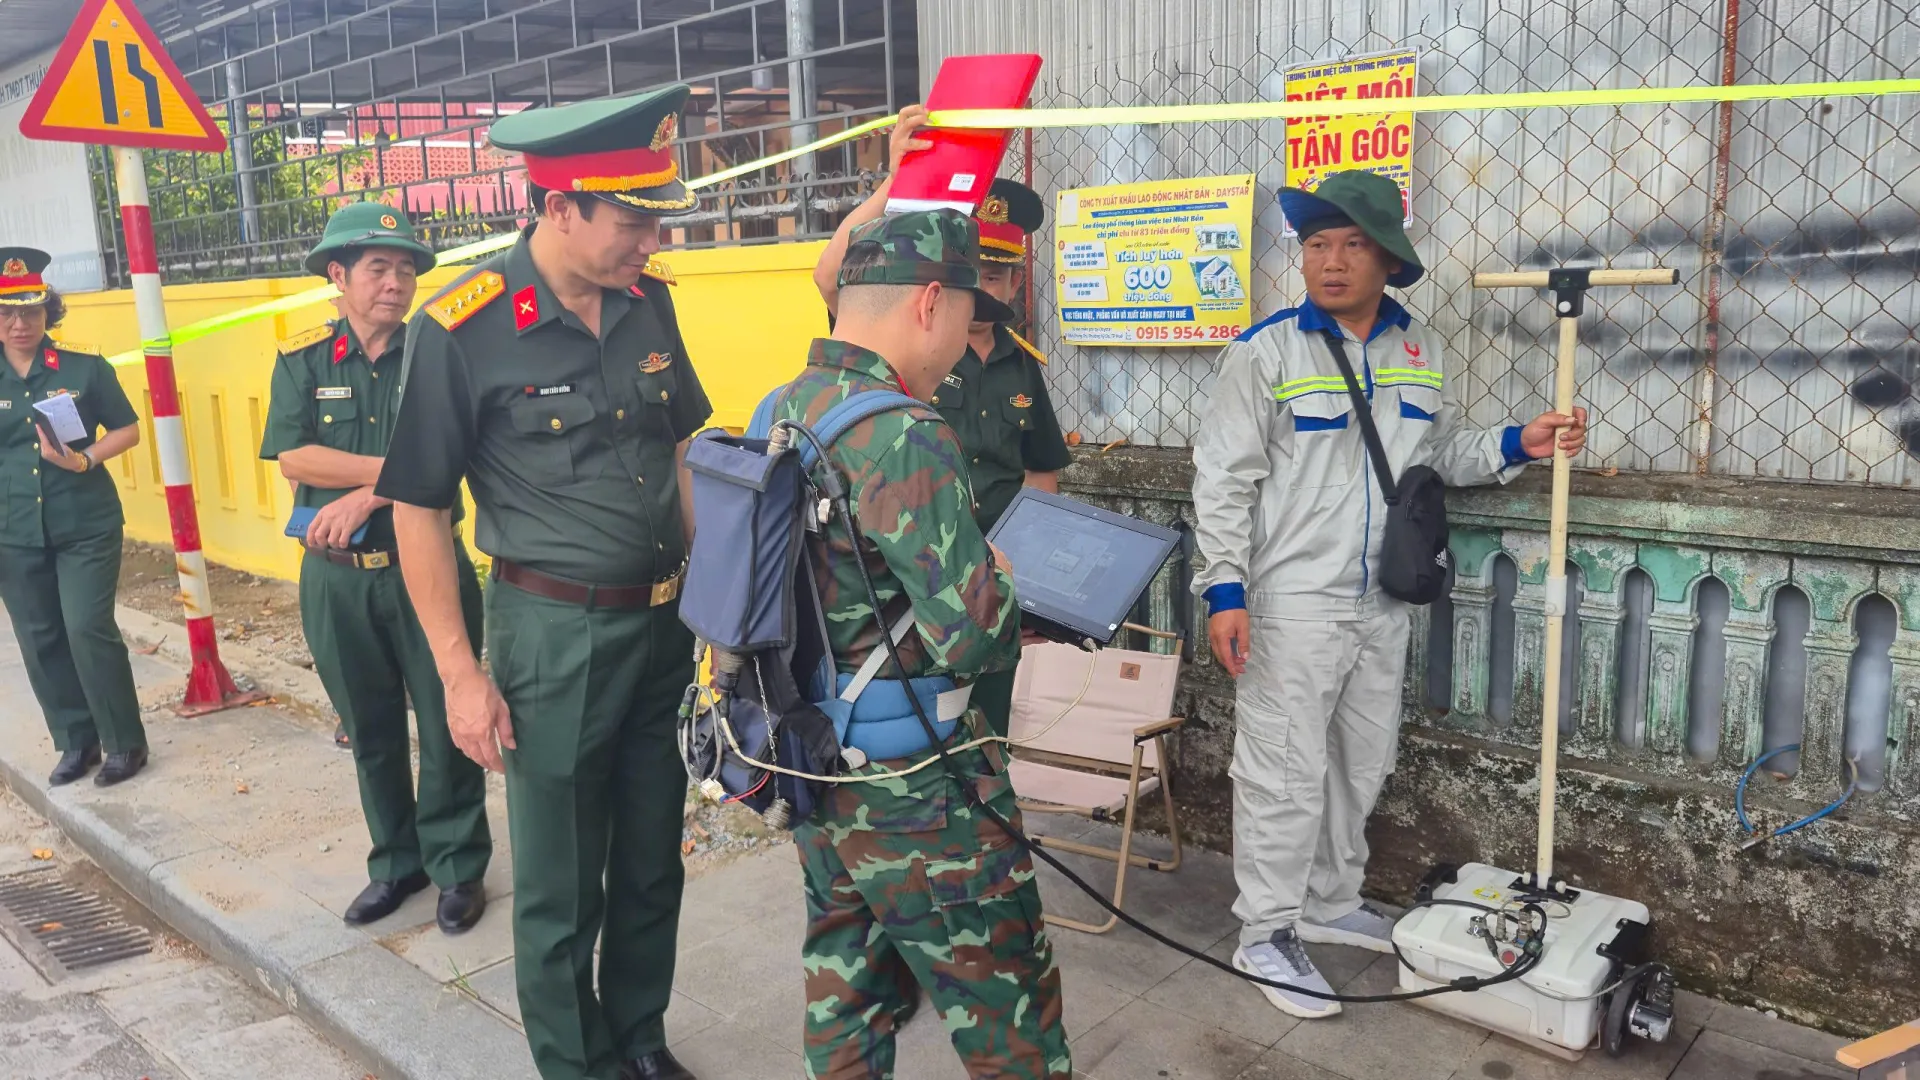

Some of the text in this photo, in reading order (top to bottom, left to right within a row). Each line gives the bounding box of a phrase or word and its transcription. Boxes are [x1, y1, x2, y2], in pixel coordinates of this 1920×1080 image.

[1288, 114, 1410, 175] TẬN GỐC
[1137, 194, 1151, 203] LAO
[1152, 190, 1172, 203] ĐỘNG
[1173, 188, 1193, 201] NHẬT
[1194, 186, 1210, 199] BẢN
[1216, 186, 1250, 198] DAYSTAR
[1115, 248, 1137, 262] Tích
[1159, 247, 1184, 261] hơn
[1123, 264, 1172, 290] 600
[1123, 290, 1172, 304] triệu đồng
[1176, 308, 1187, 319] HUẾ
[1136, 324, 1241, 340] 0915 954 286
